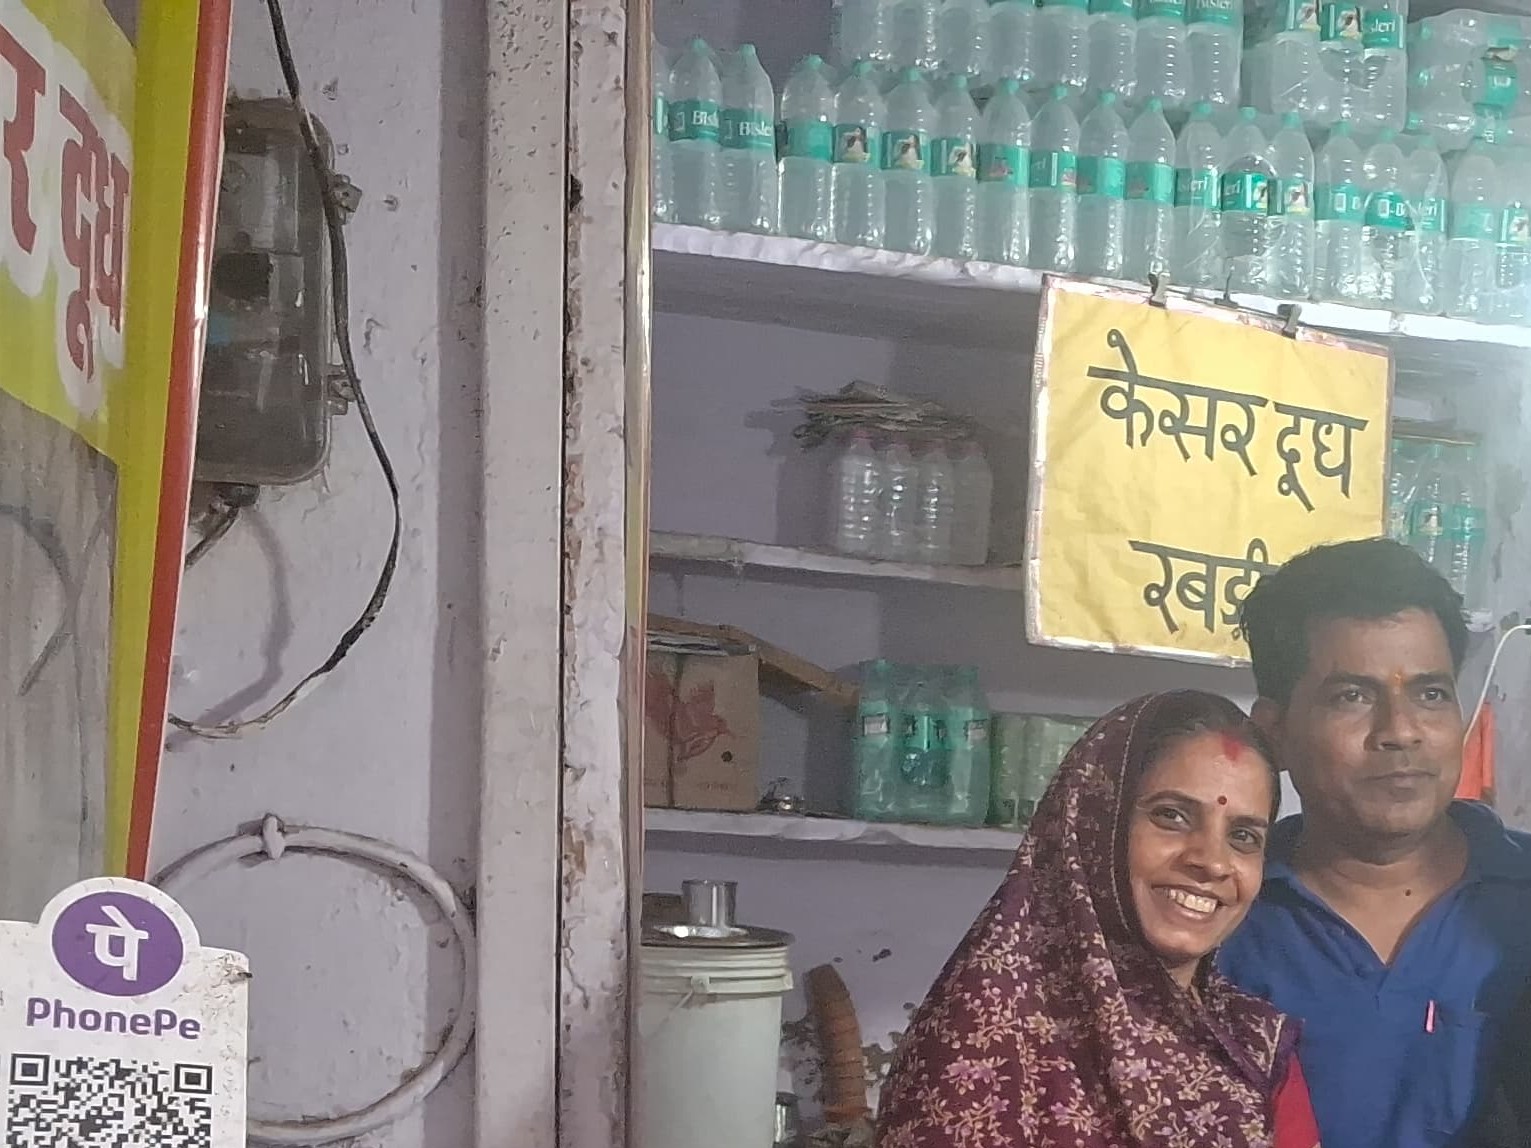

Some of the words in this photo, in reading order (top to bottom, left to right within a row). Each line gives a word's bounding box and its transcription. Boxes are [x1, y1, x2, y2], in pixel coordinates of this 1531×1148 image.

[1087, 328, 1269, 477] केसर
[1273, 401, 1369, 513] दूध
[86, 905, 149, 982] पे
[26, 997, 201, 1040] PhonePe
